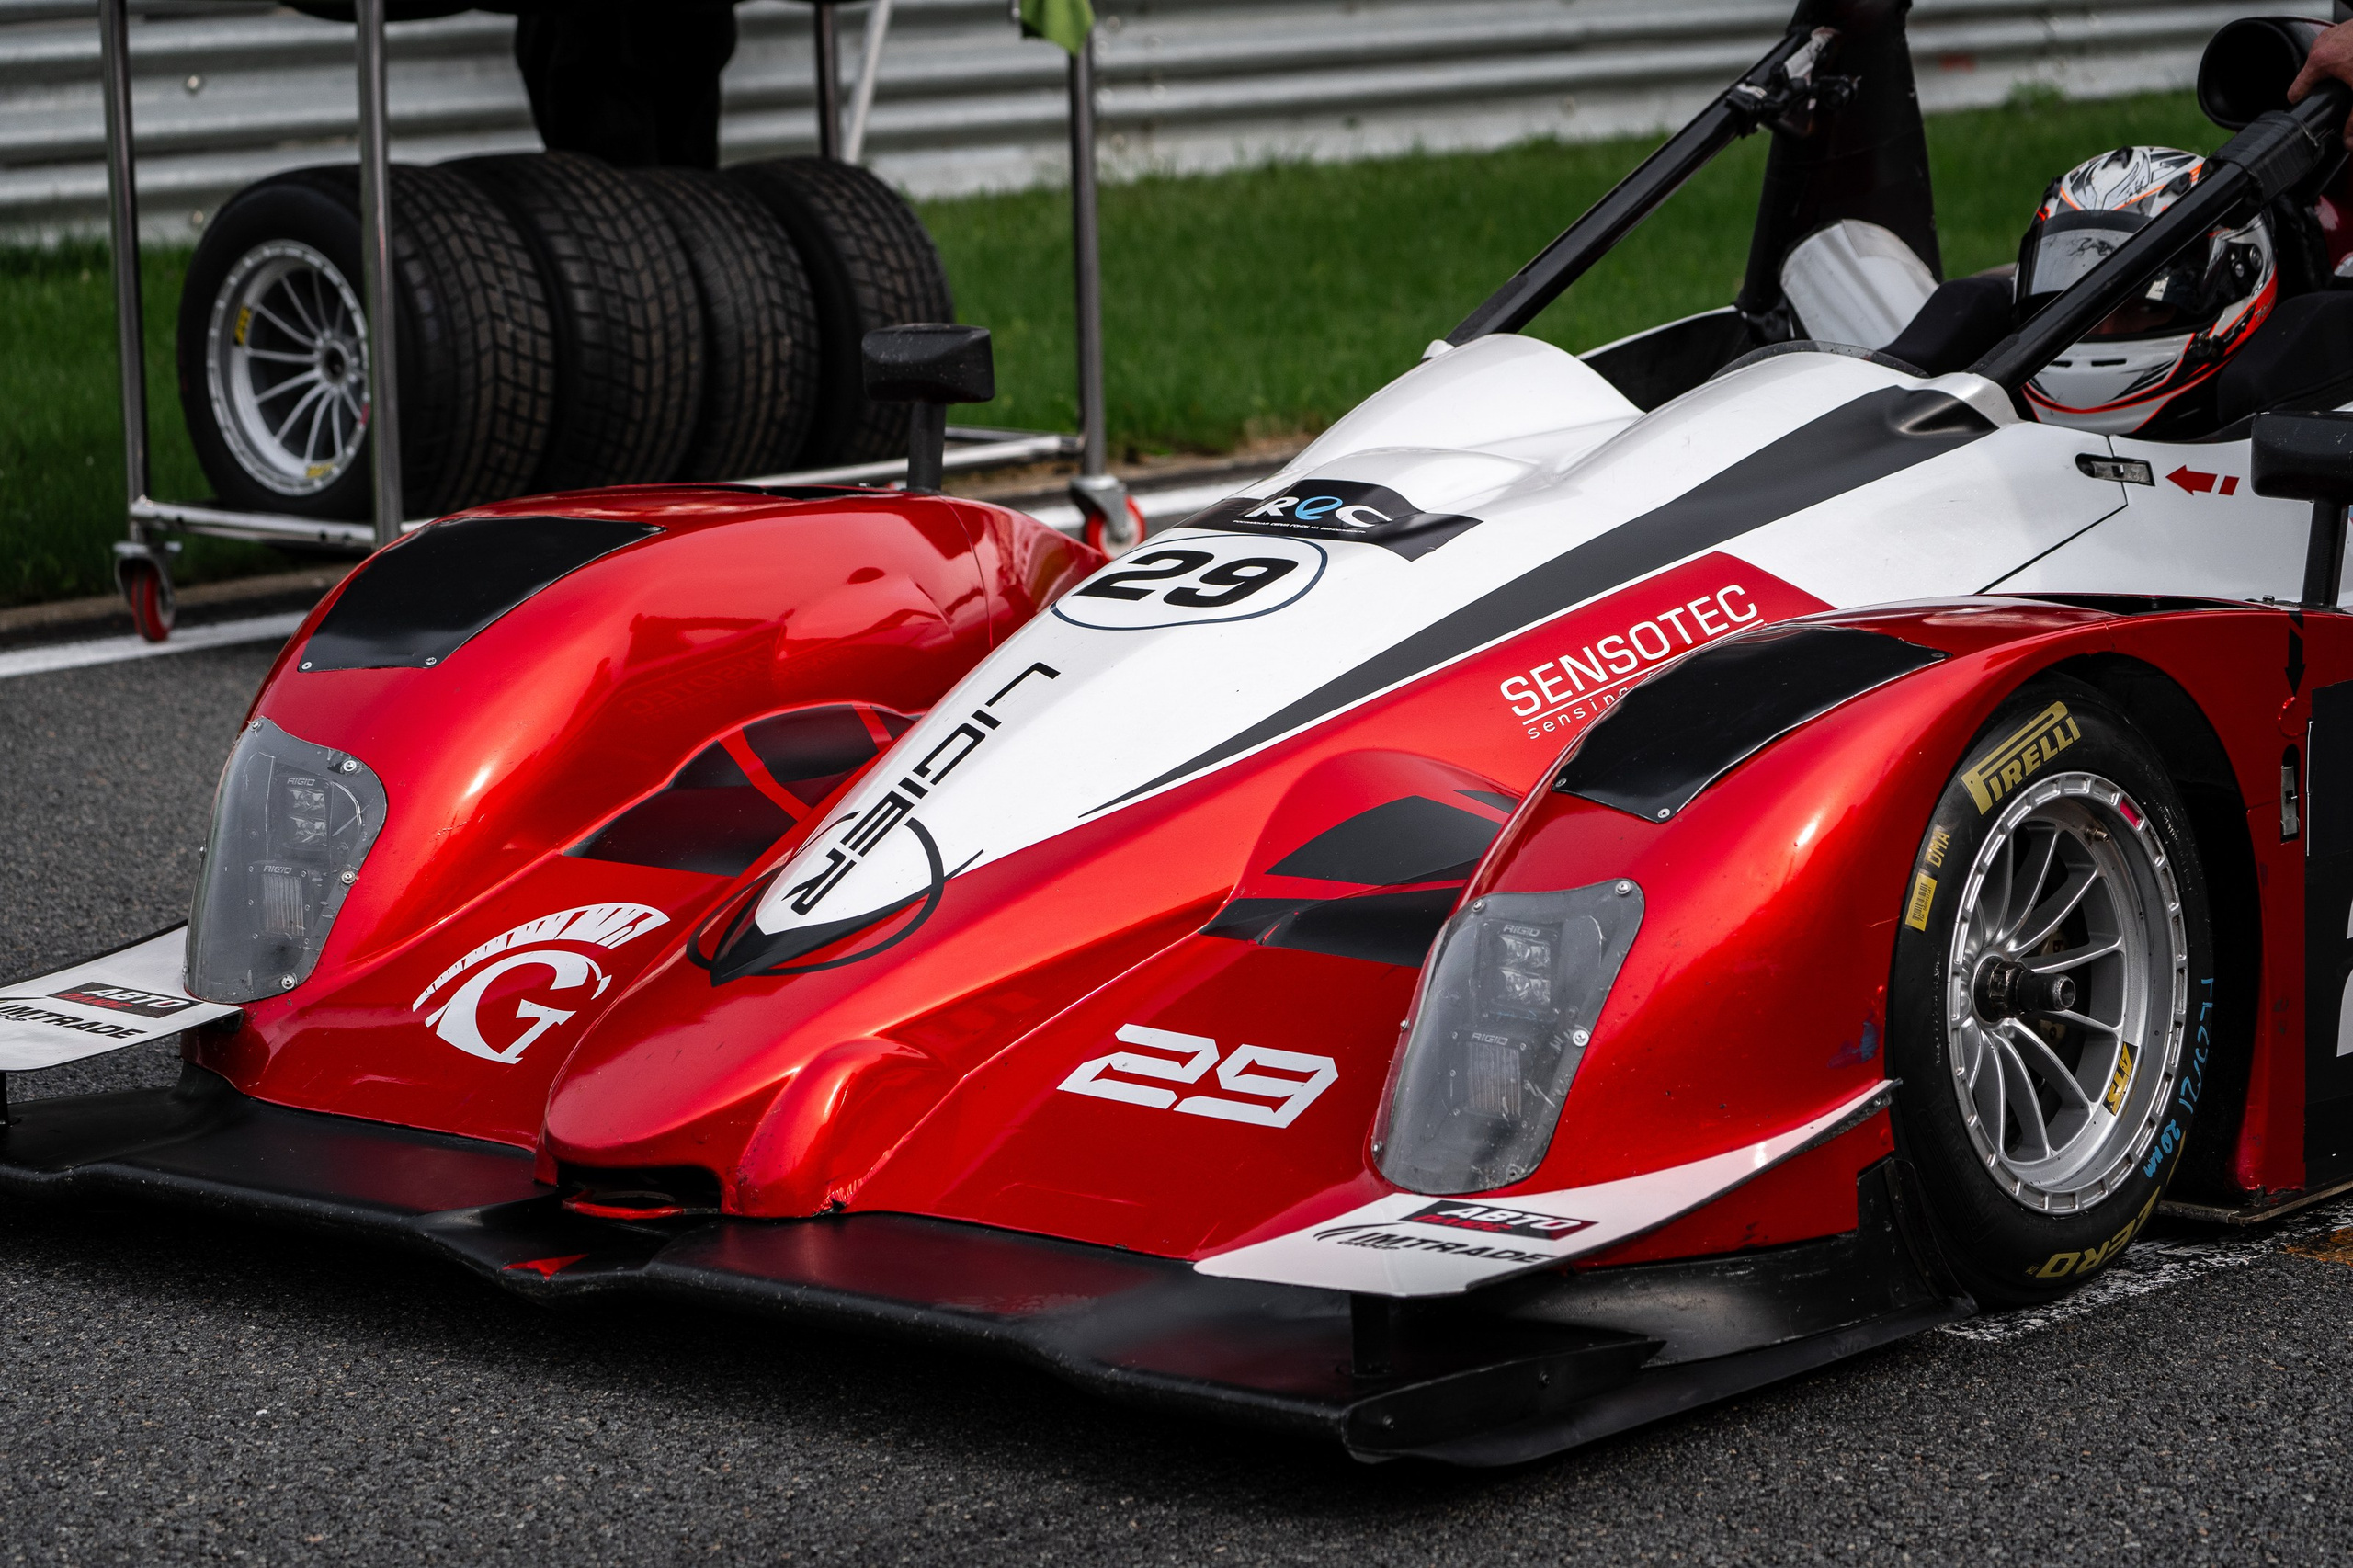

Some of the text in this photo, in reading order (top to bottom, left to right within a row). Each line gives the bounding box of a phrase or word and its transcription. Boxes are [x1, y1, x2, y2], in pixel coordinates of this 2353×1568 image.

[1071, 549, 1299, 608] 29
[1500, 585, 1758, 717] SENSOTEC
[1961, 700, 2082, 816] PIRELLI
[287, 777, 315, 787] RIGID
[781, 662, 1062, 915] LIGIER
[1927, 831, 1950, 868] DMA
[263, 865, 292, 874] RIGID
[1503, 924, 1541, 937] RIGID
[81, 988, 189, 1008] АВТО
[1471, 1032, 1509, 1045] RIGID
[1056, 1023, 1338, 1128] 29
[2107, 1041, 2133, 1116] ATS
[1437, 1206, 1582, 1230] АВТО
